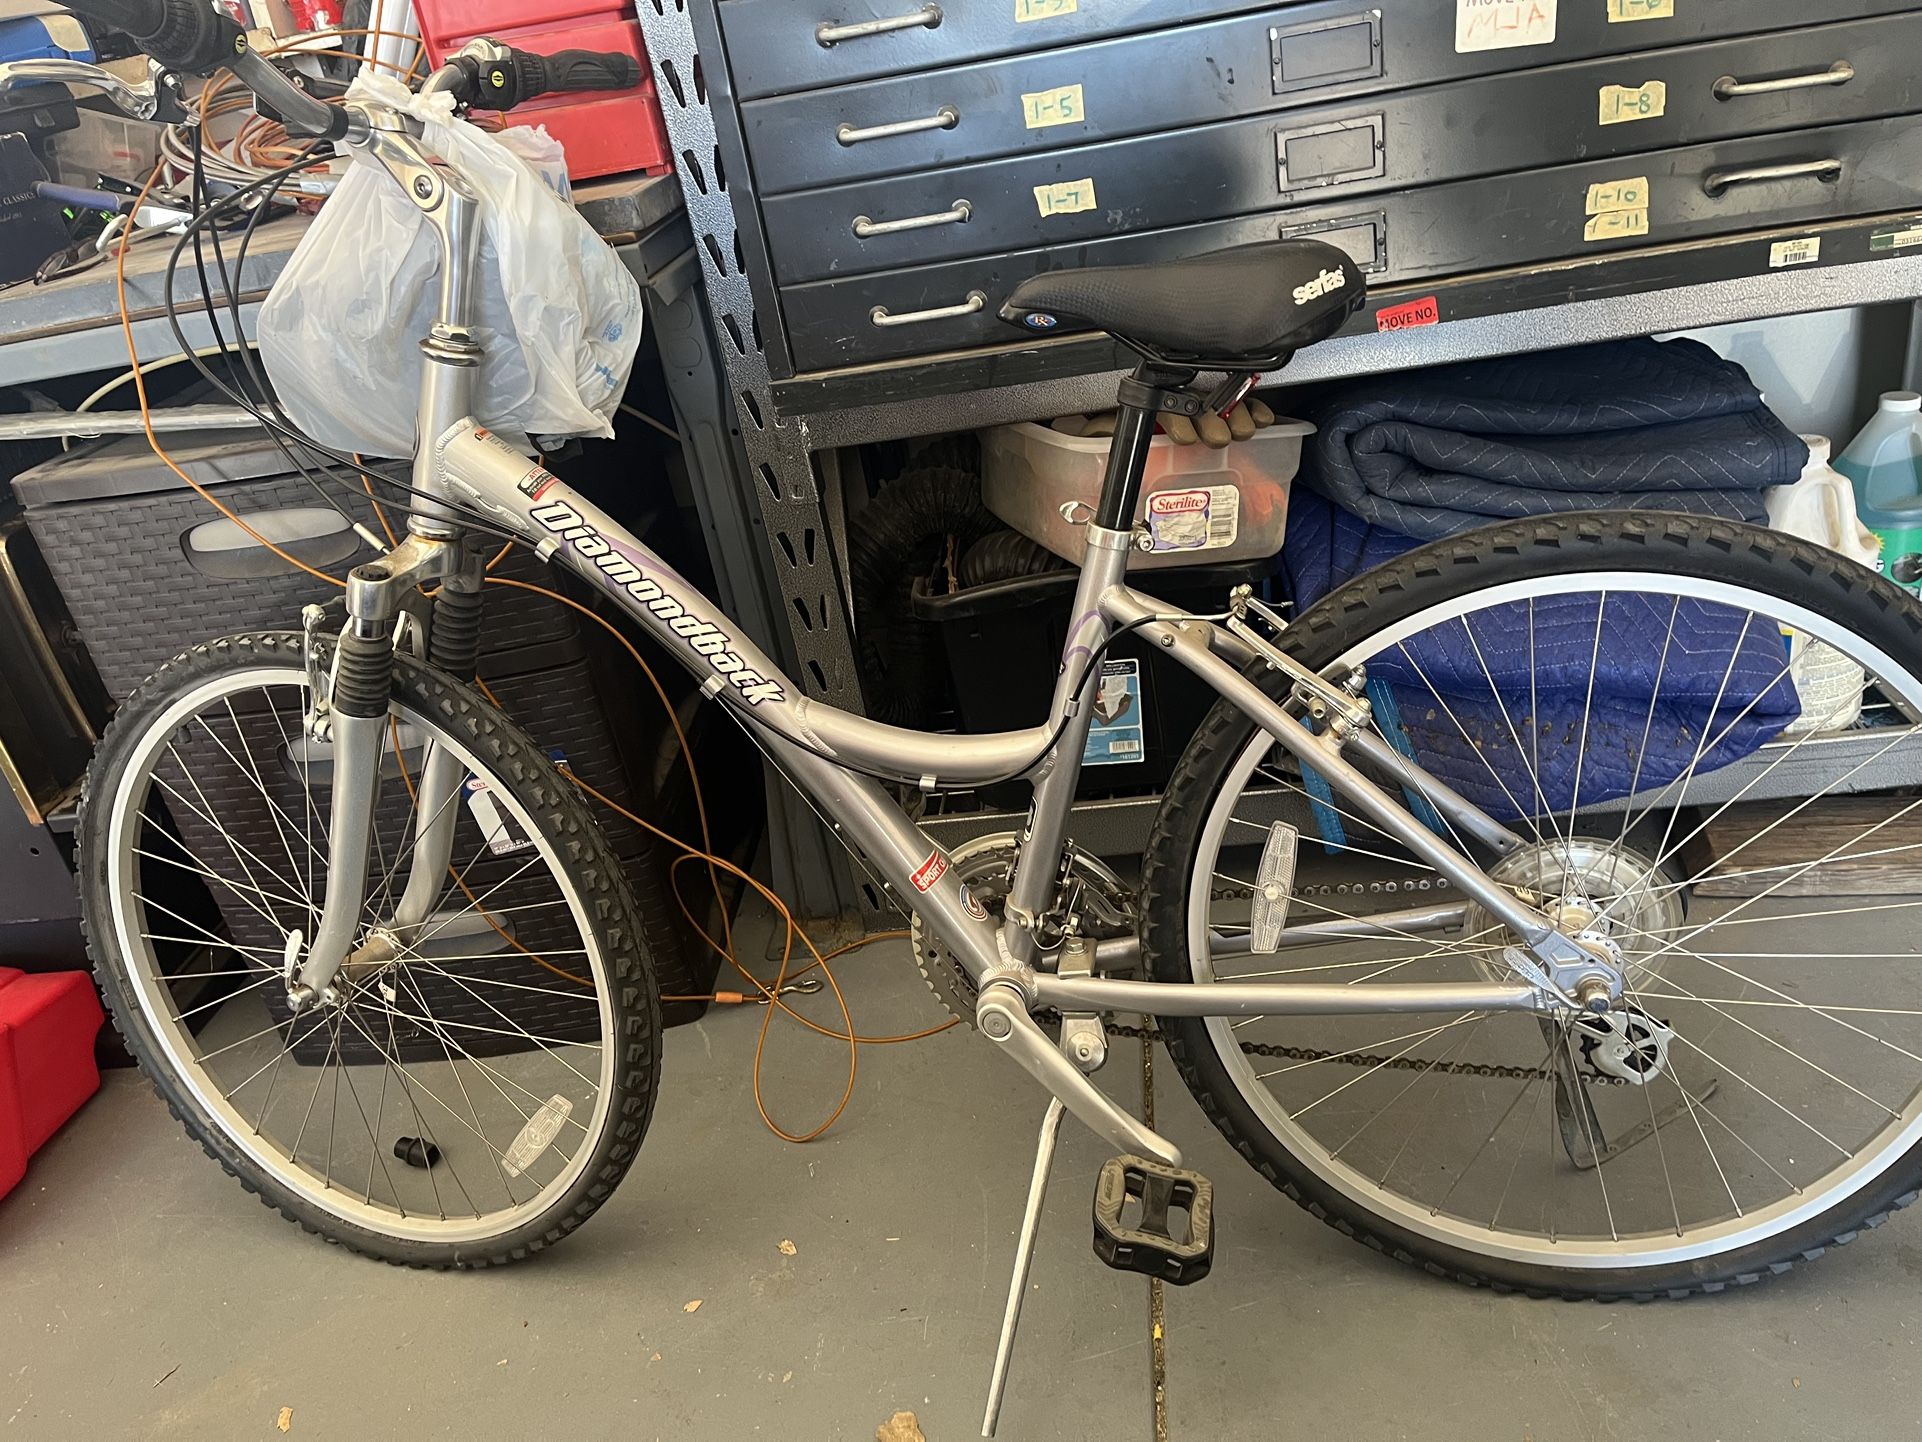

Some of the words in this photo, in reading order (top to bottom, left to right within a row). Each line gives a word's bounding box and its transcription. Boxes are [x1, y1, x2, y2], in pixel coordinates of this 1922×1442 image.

[1035, 95, 1073, 119] 1-5
[1616, 93, 1650, 115] 1-8
[1047, 191, 1079, 212] 1-7
[1595, 188, 1637, 207] 1-10
[1293, 267, 1345, 305] serfas
[1415, 306, 1436, 321] NO.
[1157, 496, 1203, 511] Sterilite
[530, 501, 785, 706] Diamondback
[917, 863, 943, 889] SPORT
